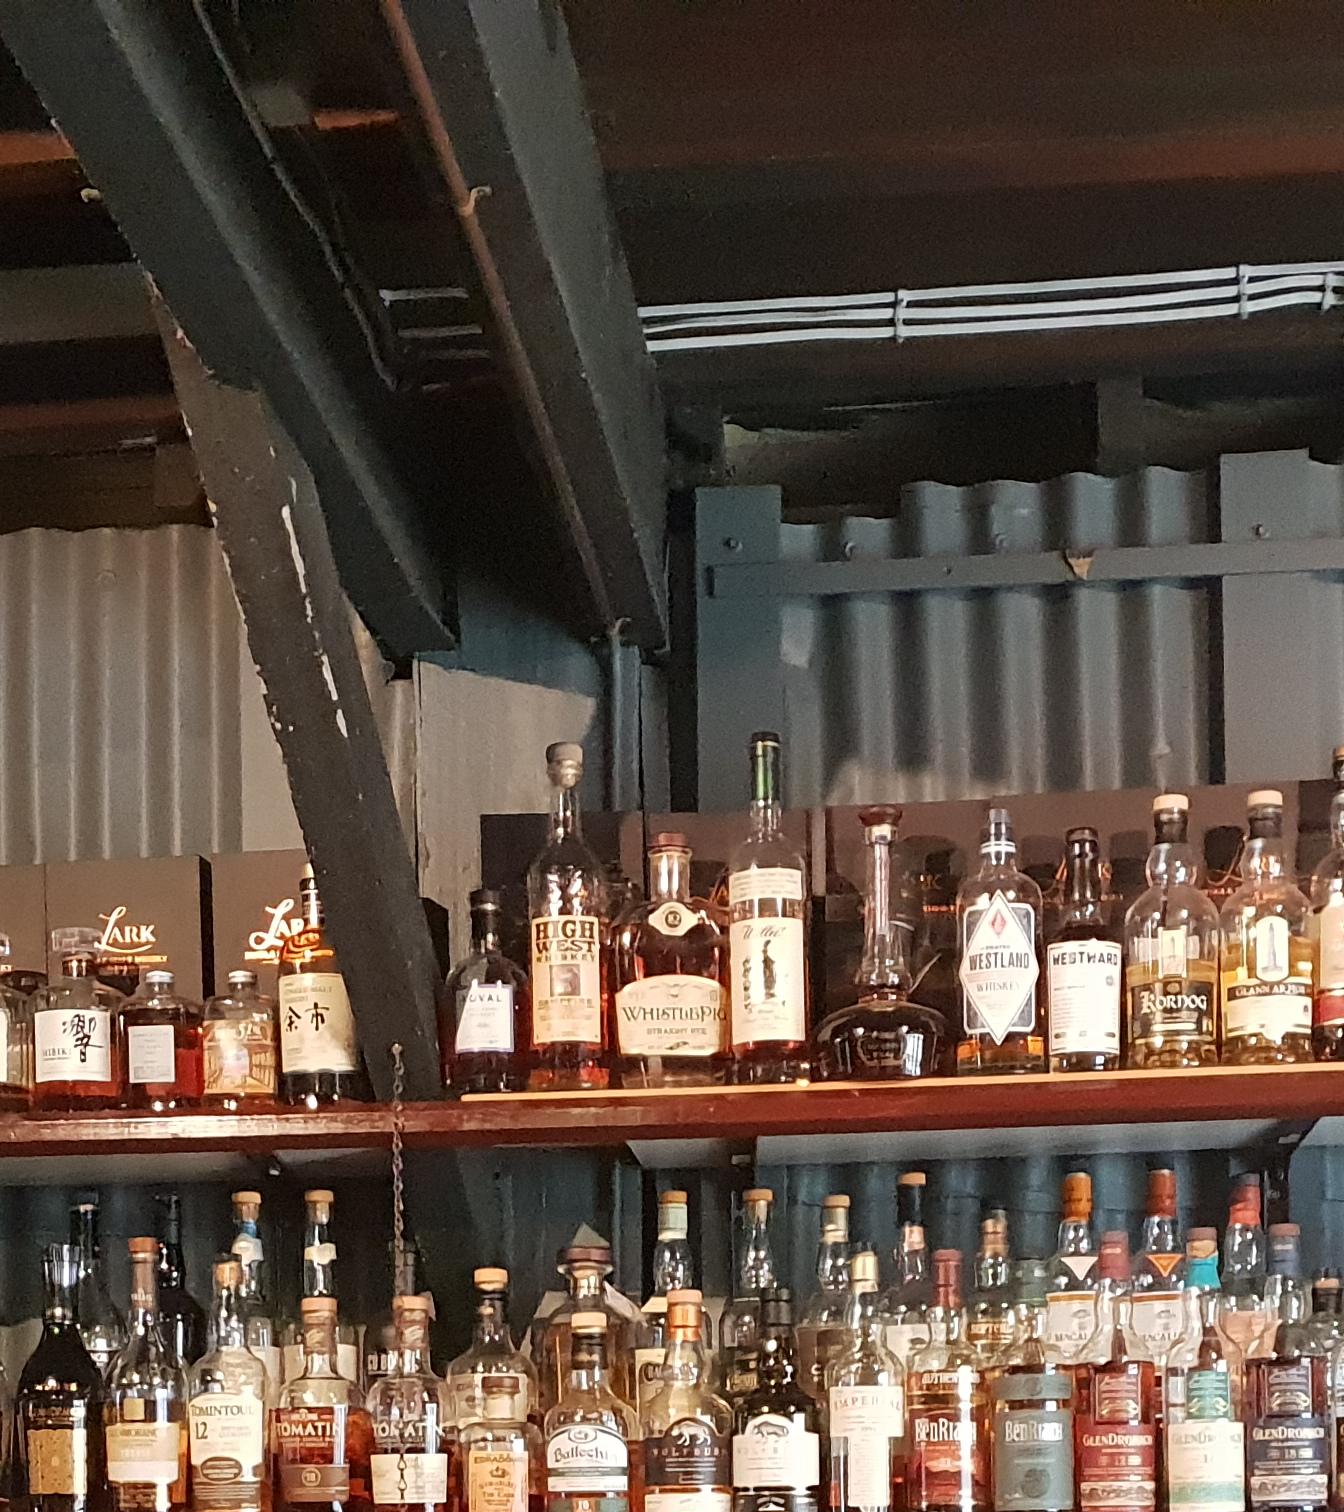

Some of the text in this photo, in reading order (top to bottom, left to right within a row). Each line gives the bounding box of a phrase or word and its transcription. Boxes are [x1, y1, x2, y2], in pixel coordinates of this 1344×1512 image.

[535, 921, 596, 940] HIGH
[535, 940, 596, 954] WEST
[968, 952, 1030, 971] WESTLAND
[1052, 951, 1118, 966] WESTWARD
[195, 1423, 208, 1440] 12
